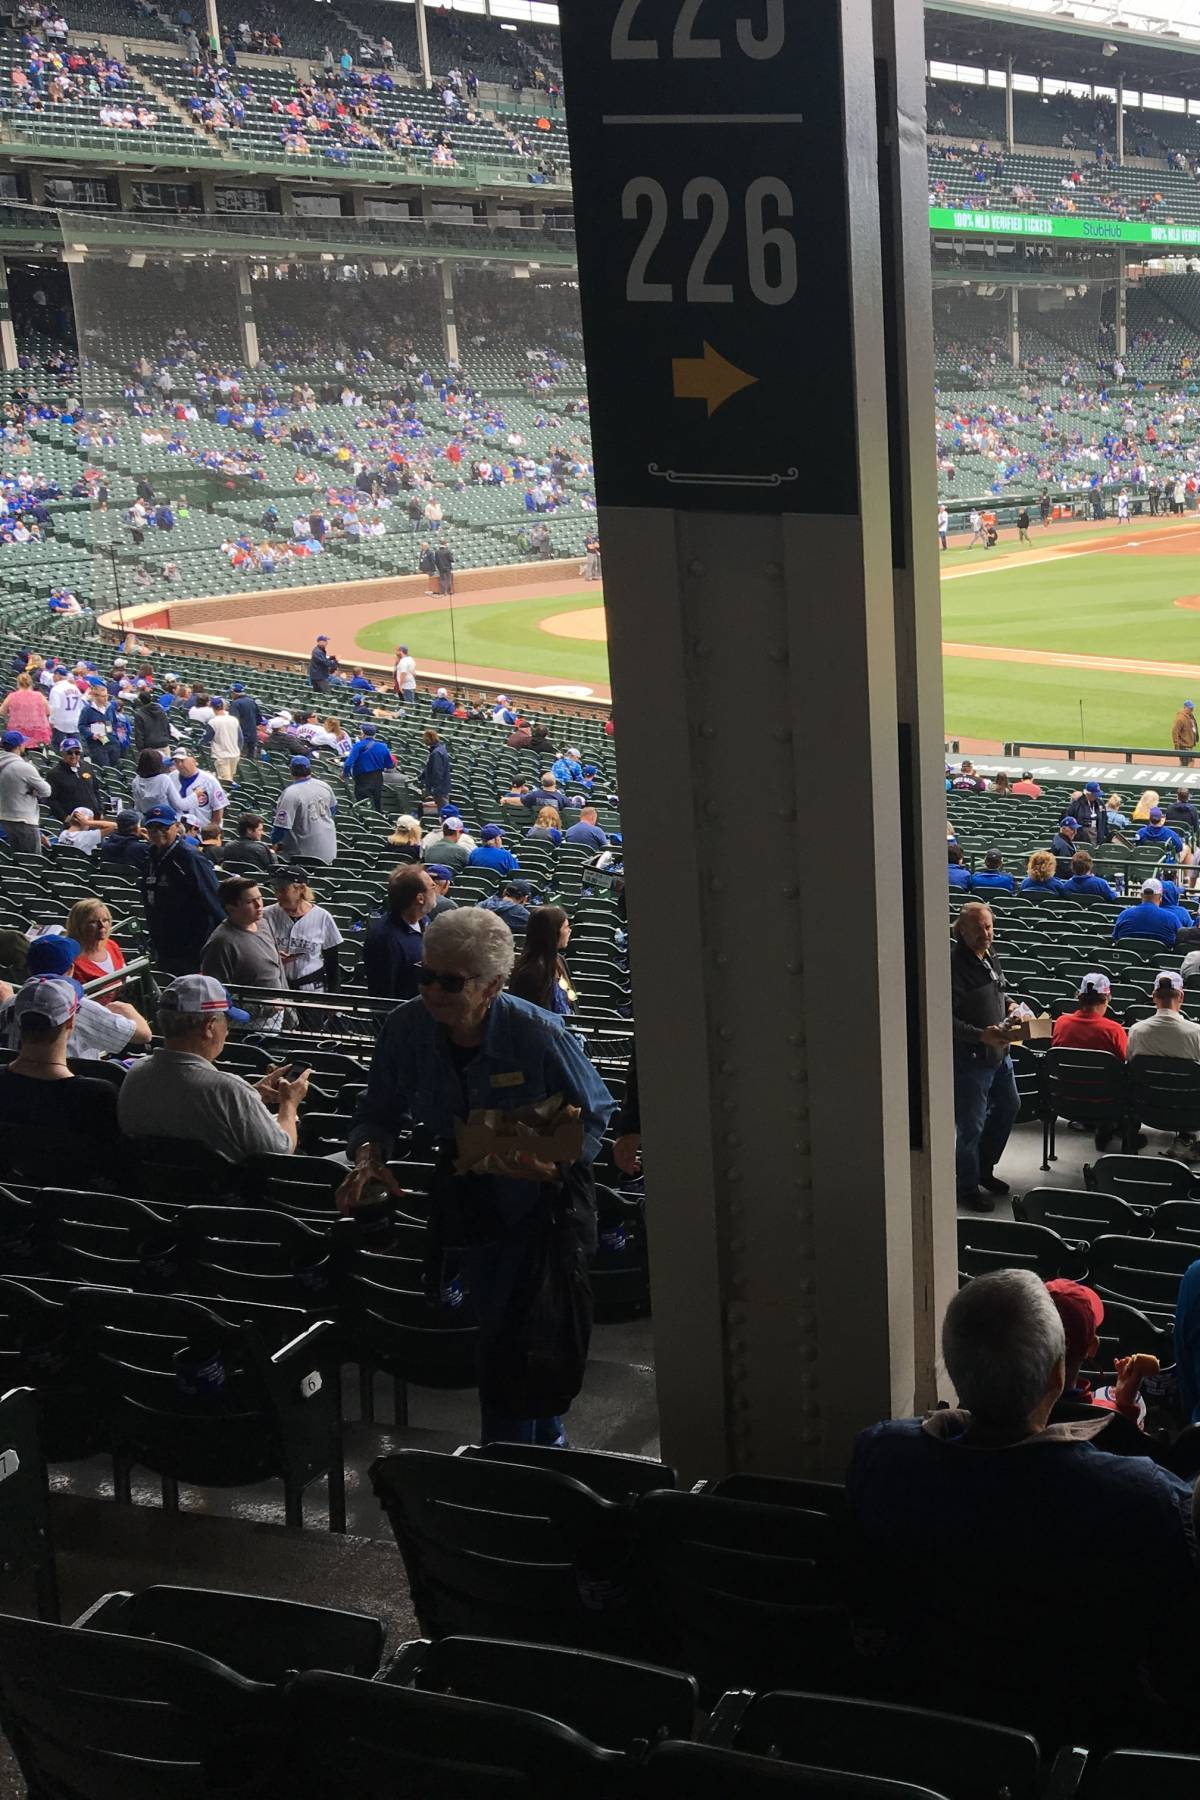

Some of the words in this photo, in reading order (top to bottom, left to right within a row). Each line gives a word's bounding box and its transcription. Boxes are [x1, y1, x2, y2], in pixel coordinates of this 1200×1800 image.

[953, 212, 974, 228] 100%
[991, 215, 1022, 231] VERIFIED
[1023, 217, 1053, 234] TICKETS
[1083, 222, 1122, 238] StubHub
[621, 176, 798, 305] 226
[65, 696, 79, 711] 17
[1067, 766, 1125, 779] THE
[308, 1378, 316, 1391] 6
